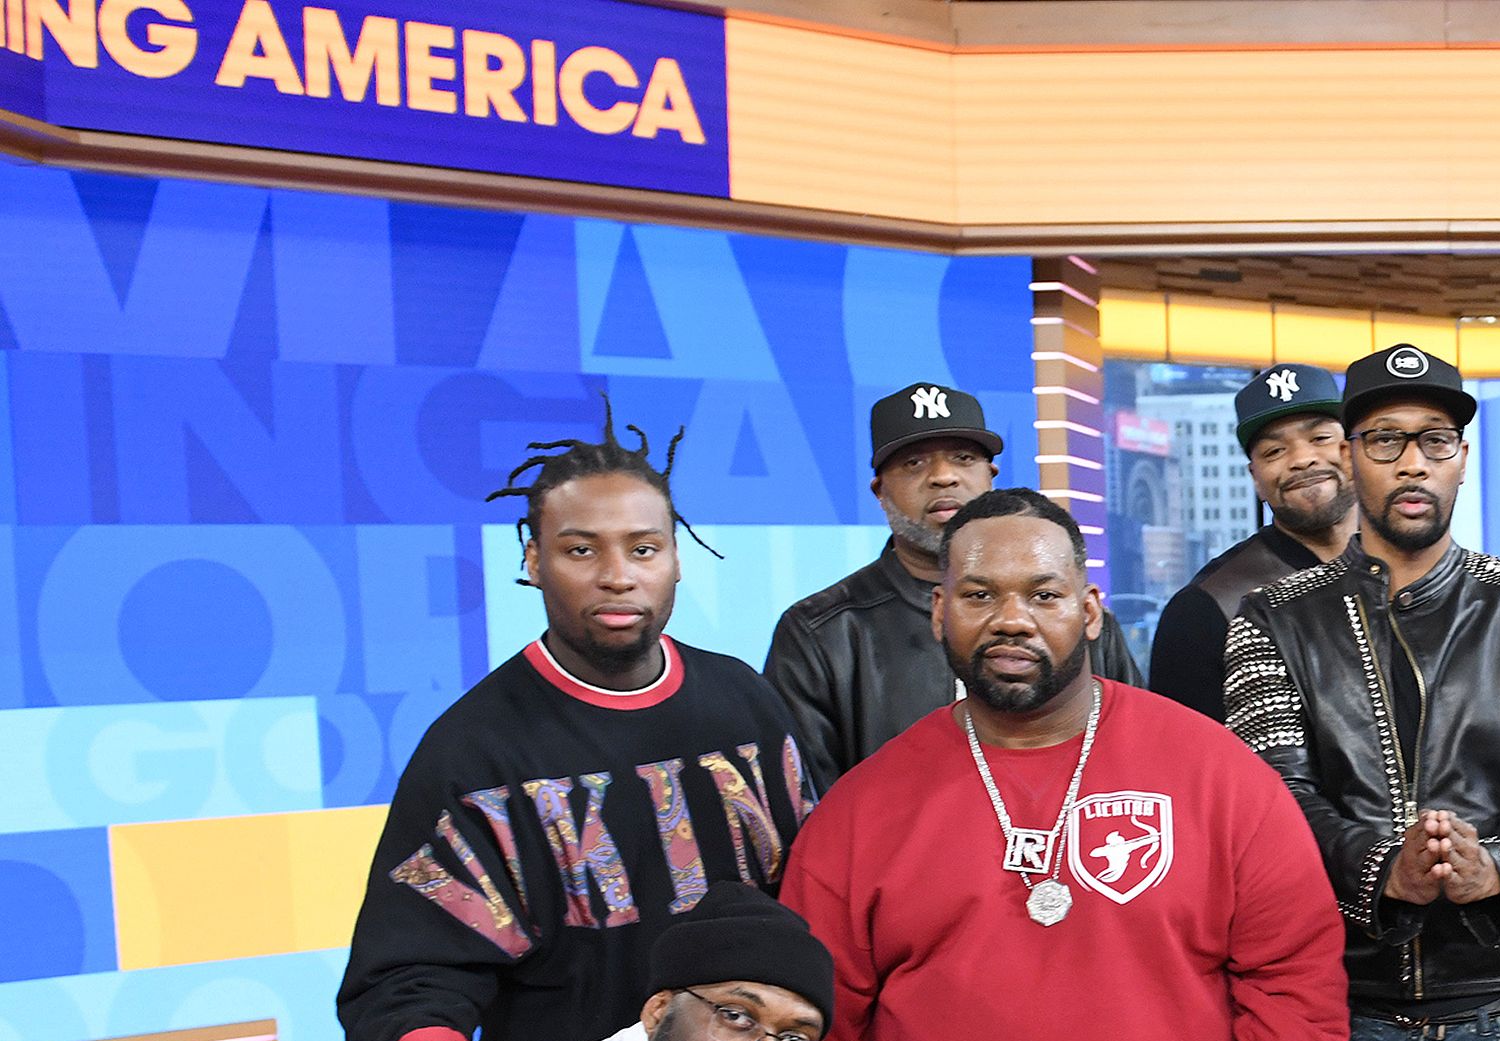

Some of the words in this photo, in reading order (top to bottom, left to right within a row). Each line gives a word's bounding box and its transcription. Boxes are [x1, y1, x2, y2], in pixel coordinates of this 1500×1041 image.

[0, 0, 199, 78] ING
[214, 0, 707, 145] AMERICA
[1265, 368, 1300, 402] NY
[910, 386, 951, 419] NY
